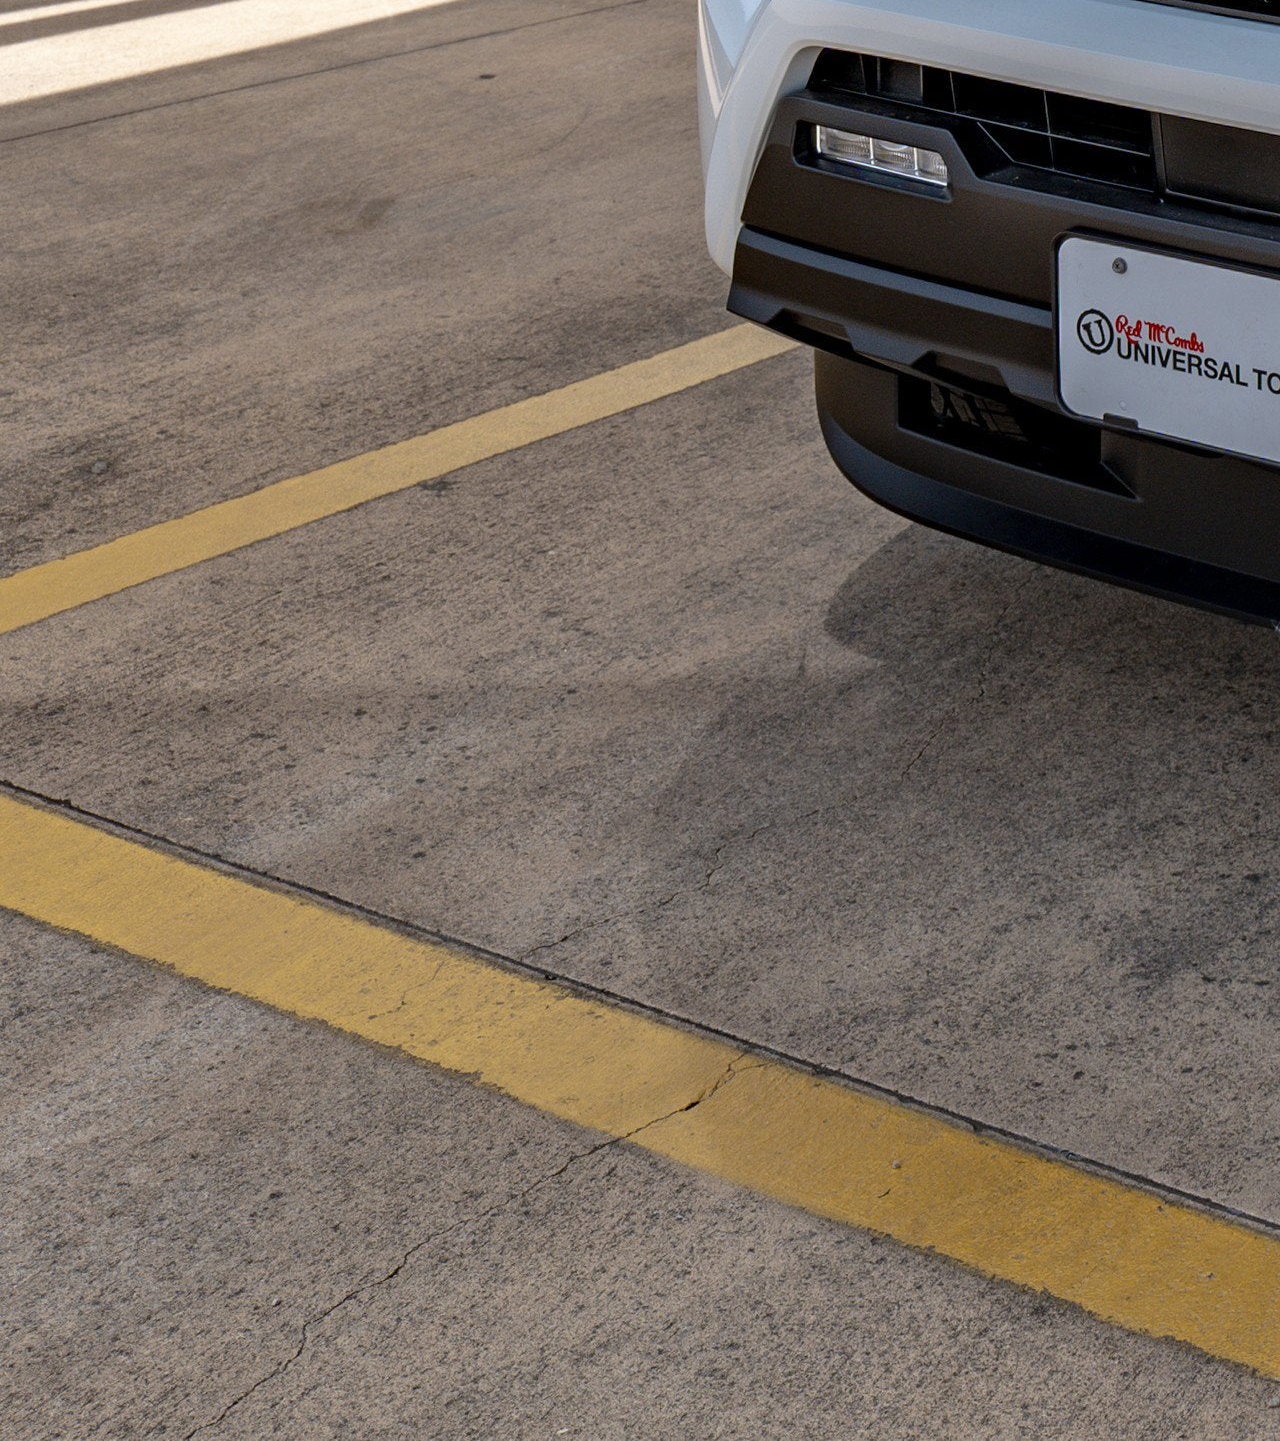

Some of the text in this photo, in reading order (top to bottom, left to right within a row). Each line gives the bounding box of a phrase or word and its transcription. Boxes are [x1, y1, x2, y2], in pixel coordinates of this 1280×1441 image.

[1115, 314, 1205, 354] Red McCombs
[1117, 337, 1248, 387] UNIVERSAL
